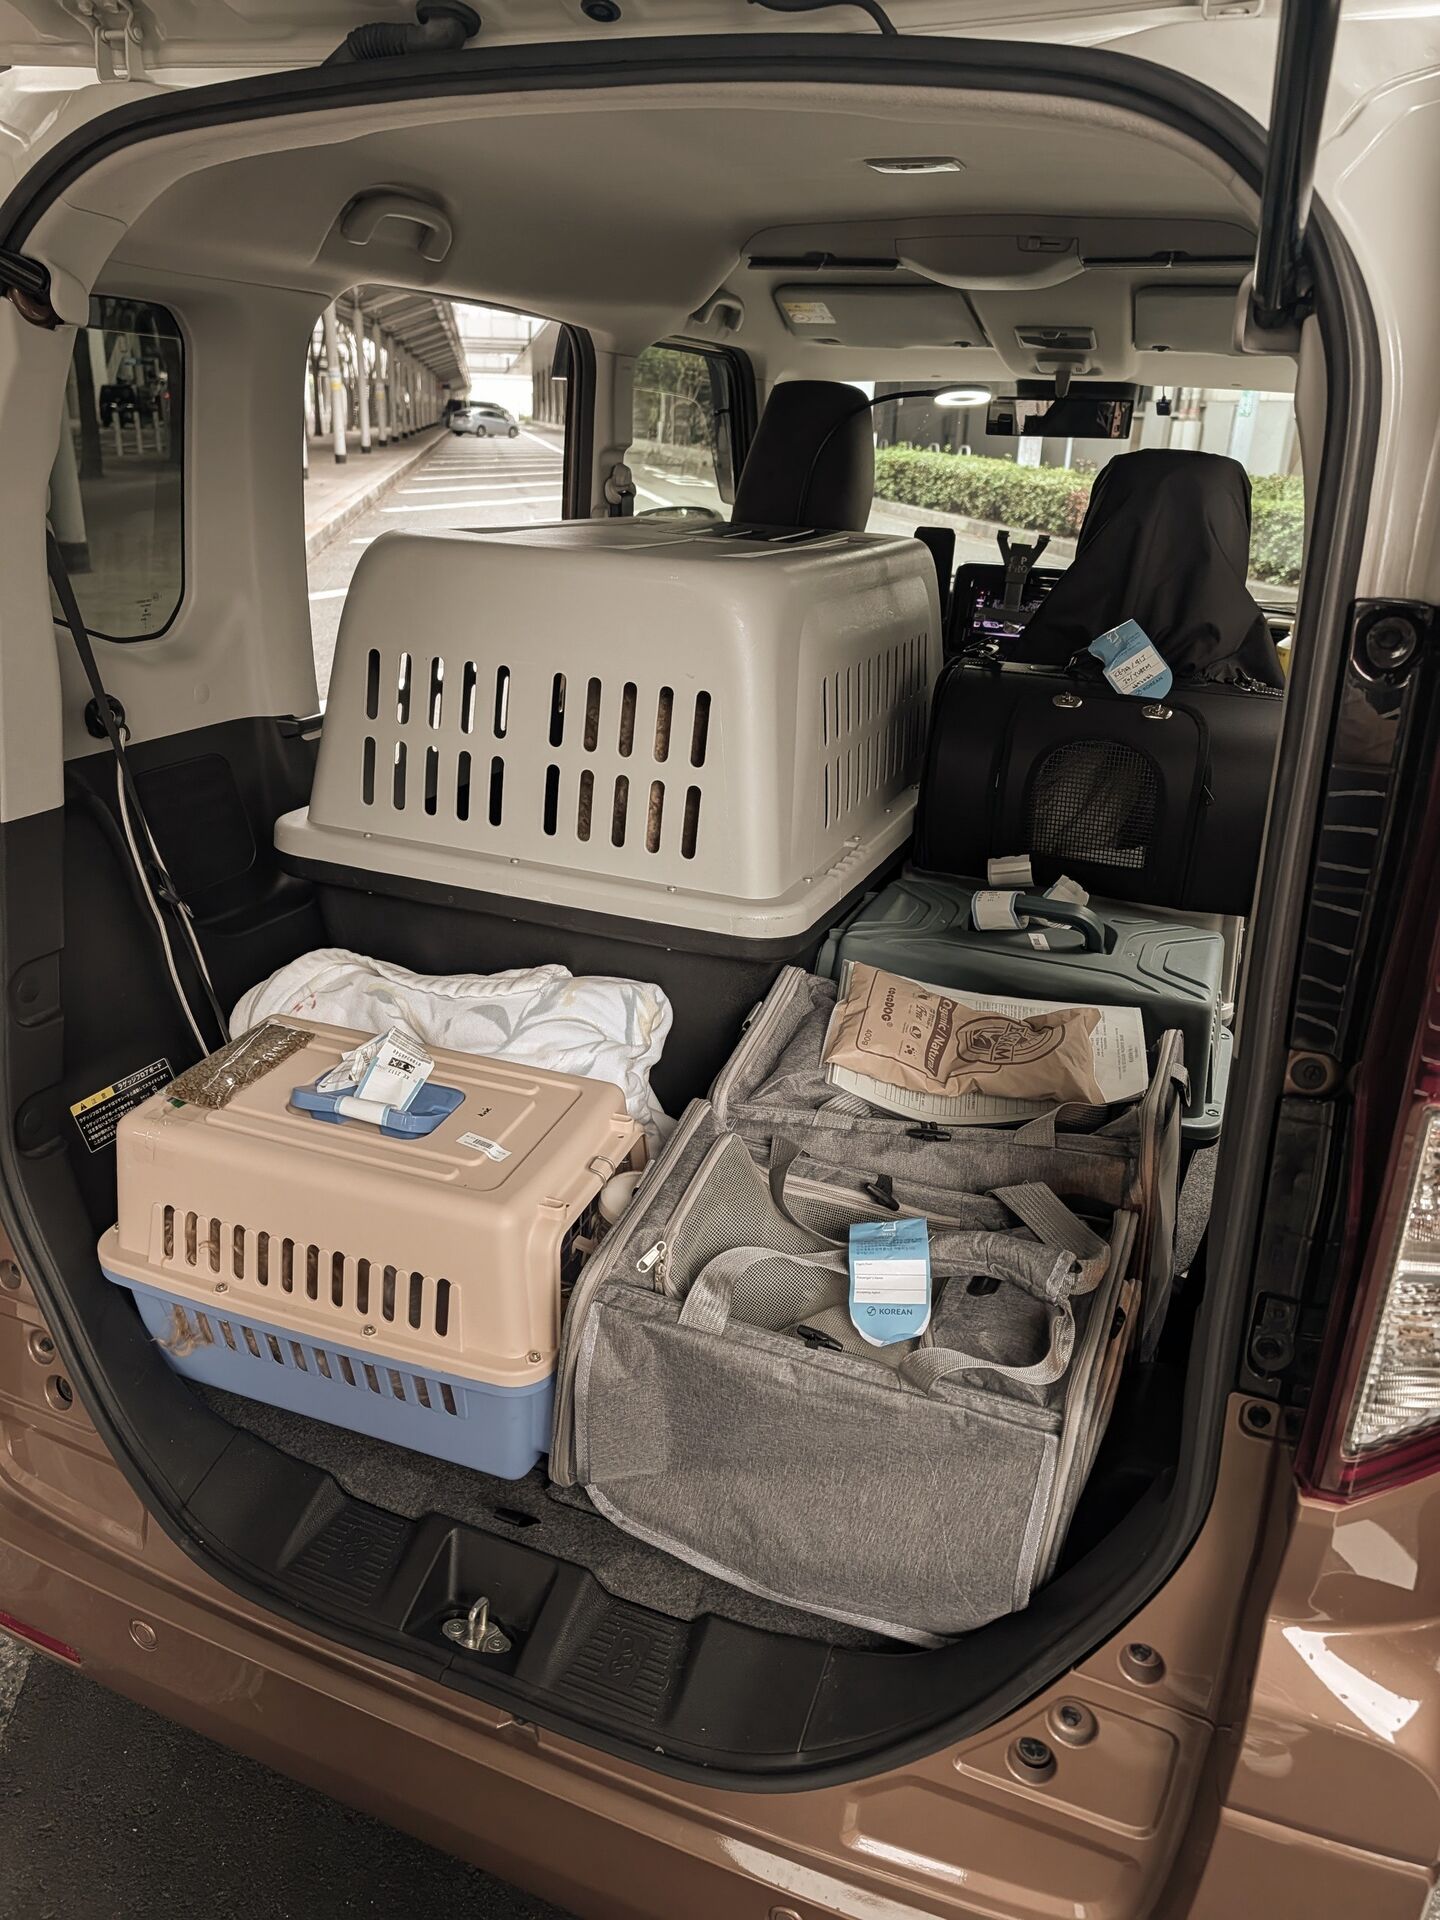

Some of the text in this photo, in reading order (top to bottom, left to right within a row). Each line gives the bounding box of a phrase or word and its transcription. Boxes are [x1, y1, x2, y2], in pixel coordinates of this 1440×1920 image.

[881, 987, 896, 1022] cocoDOG
[861, 1029, 873, 1046] 400g
[389, 1057, 415, 1073] KIX
[117, 1063, 162, 1090] ラゲッジフロアボード
[879, 1308, 913, 1316] KOREAN
